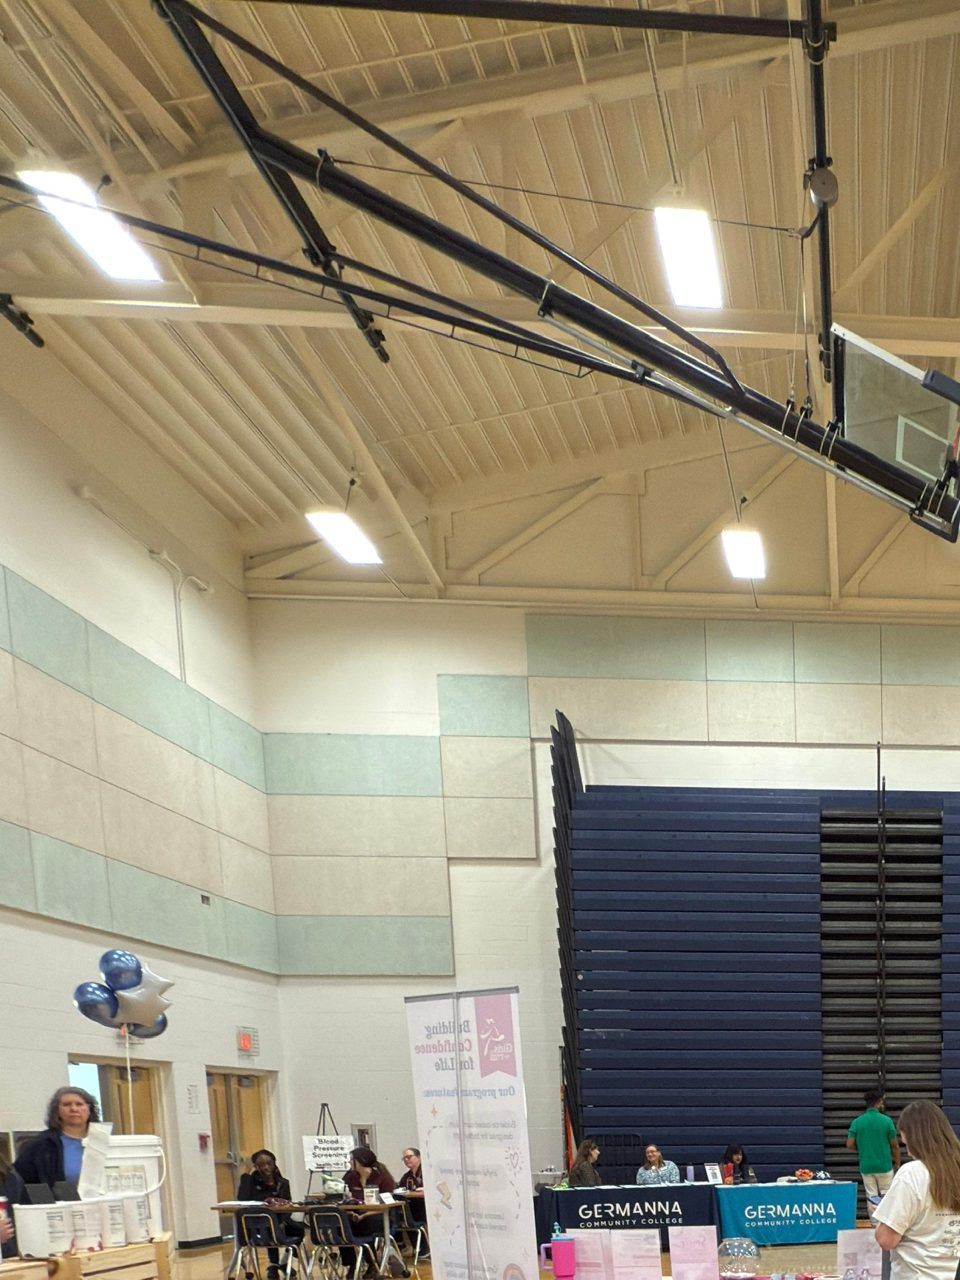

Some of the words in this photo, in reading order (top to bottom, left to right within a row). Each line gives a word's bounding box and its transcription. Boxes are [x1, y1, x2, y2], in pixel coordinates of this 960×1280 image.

[578, 1201, 682, 1219] GERMANNA
[744, 1202, 836, 1219] GERMANNA
[579, 1219, 637, 1228] COMMUNITY
[641, 1217, 683, 1225] COLLEGE
[745, 1219, 797, 1228] COMMUNITY
[799, 1218, 837, 1226] COLLEGE
